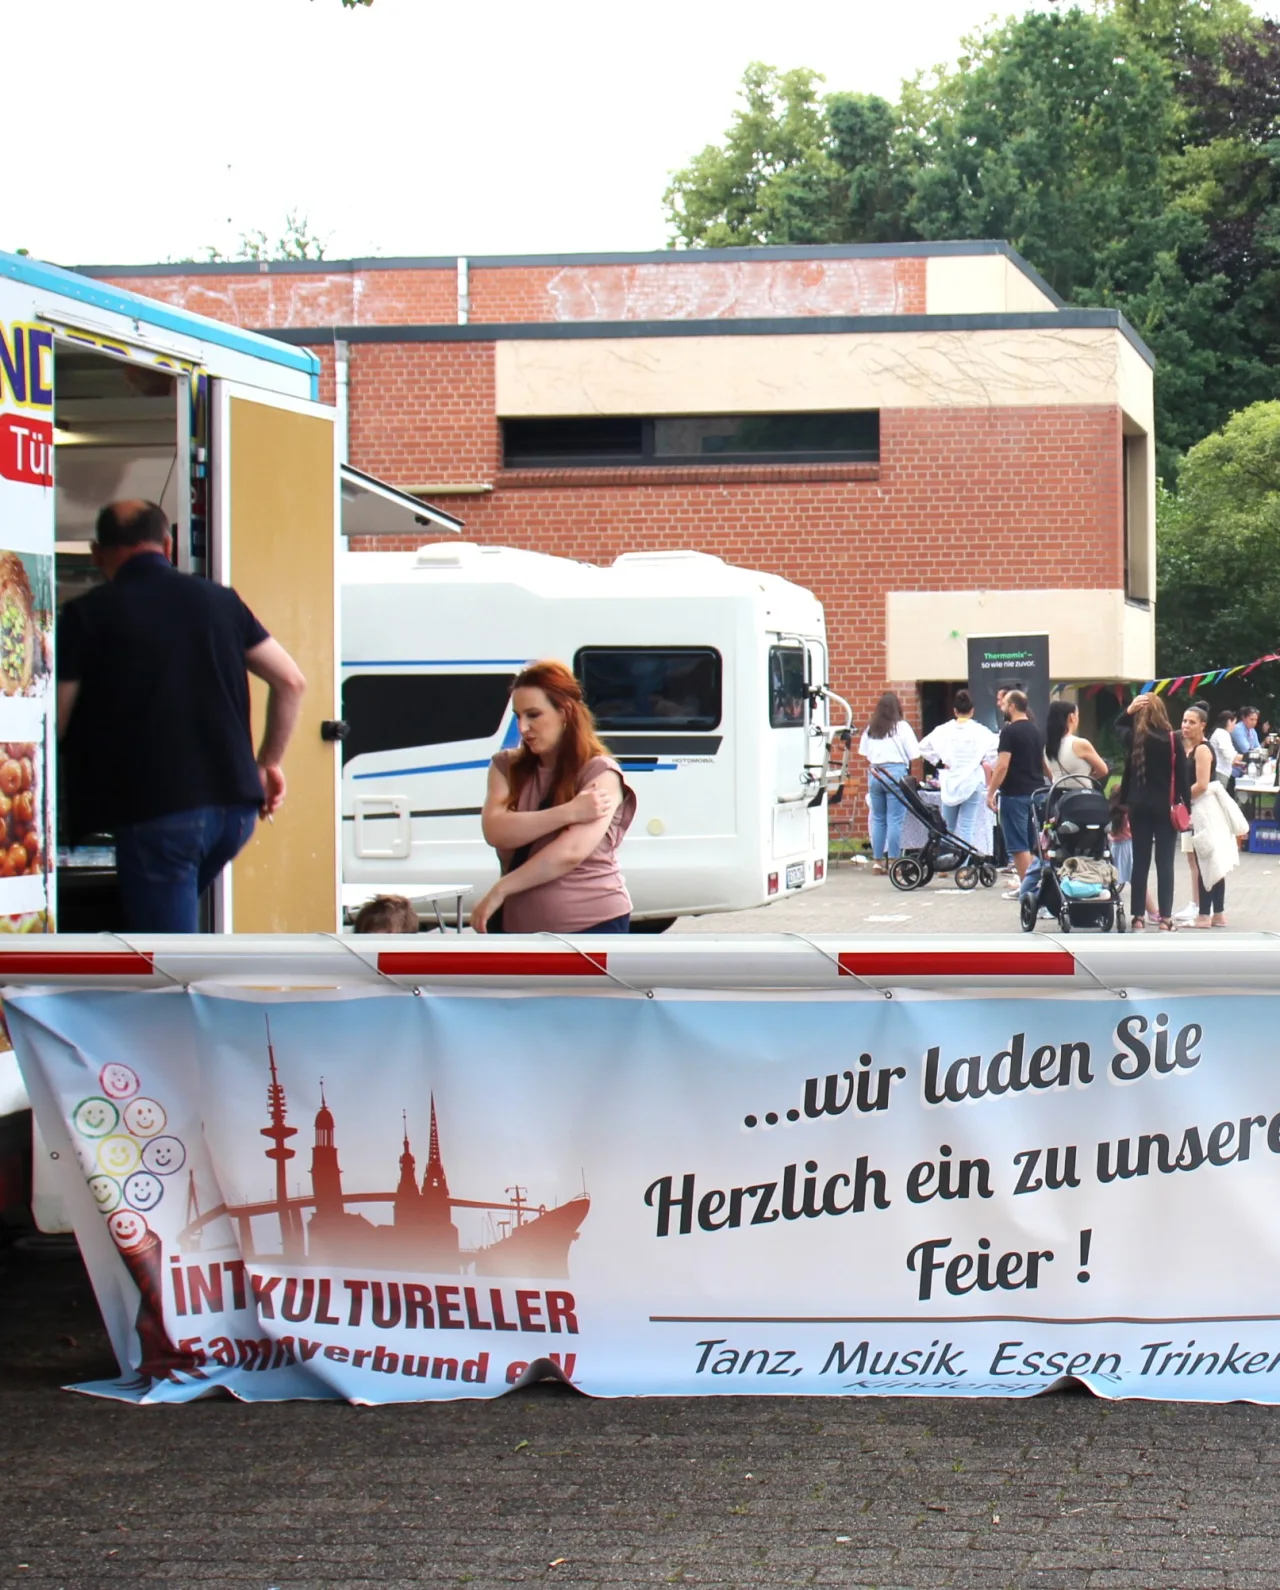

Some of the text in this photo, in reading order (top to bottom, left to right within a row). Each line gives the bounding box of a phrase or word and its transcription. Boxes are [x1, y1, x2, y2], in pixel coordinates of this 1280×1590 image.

[923, 1031, 1095, 1106] laden
[1112, 1012, 1203, 1082] Sie
[644, 1154, 892, 1237] Herzlich
[906, 1145, 995, 1200] ein
[1012, 1145, 1082, 1196] zu
[907, 1229, 1094, 1301] Feier !
[694, 1339, 804, 1378] Tanz,
[818, 1340, 970, 1378] Musik,
[988, 1340, 1128, 1378] Essen
